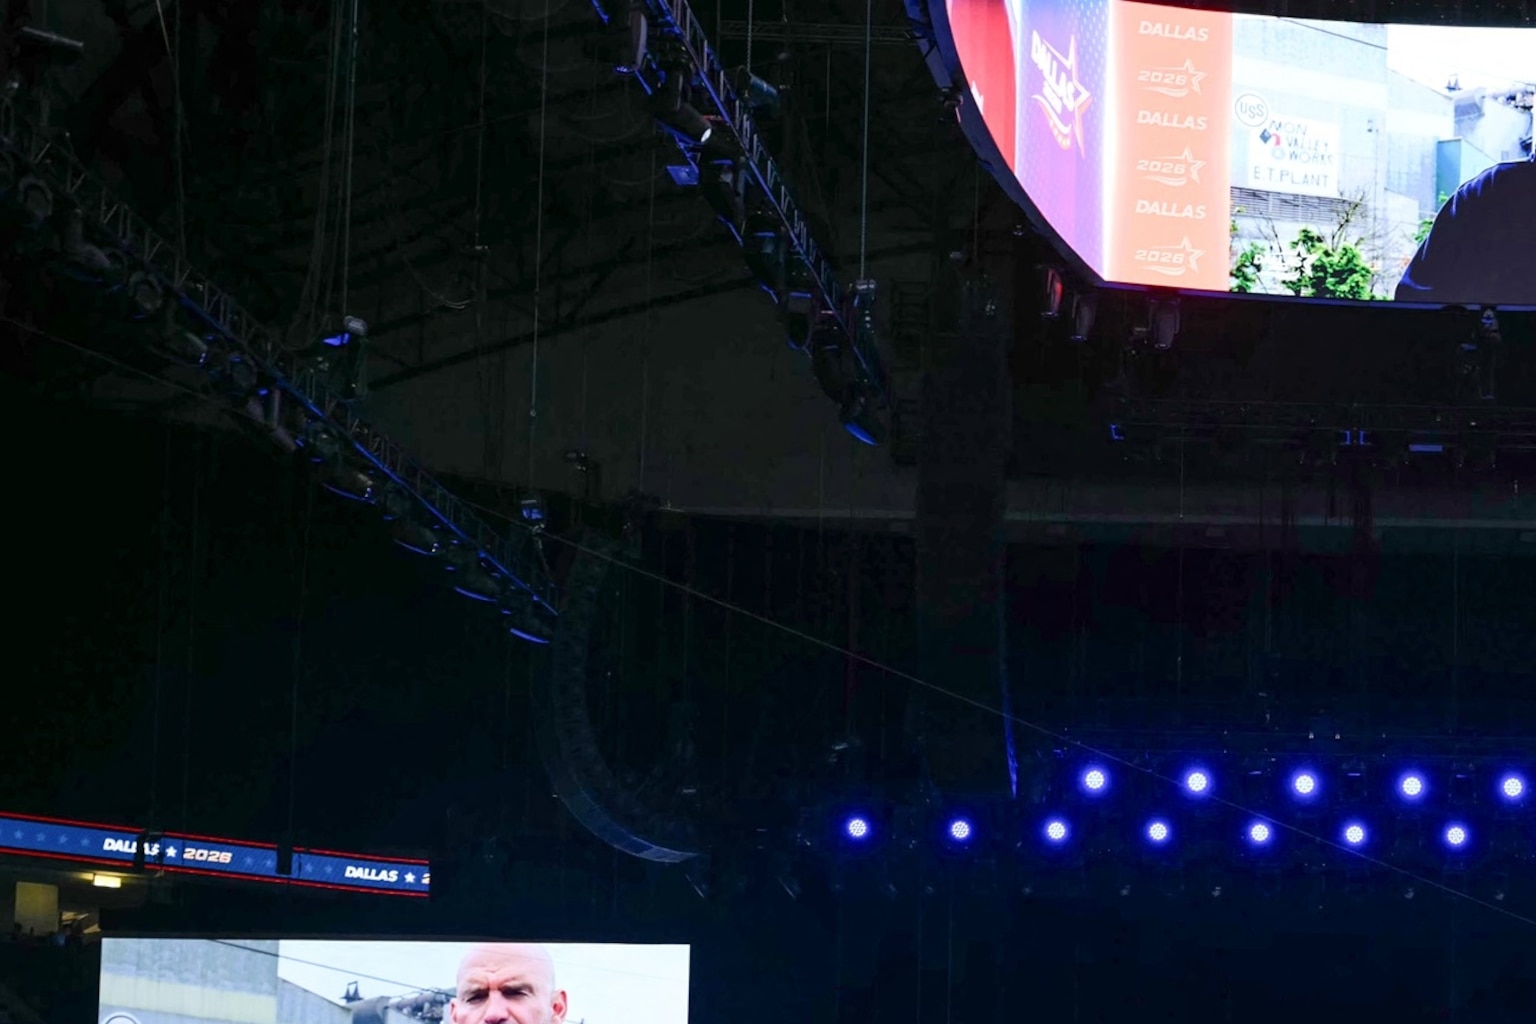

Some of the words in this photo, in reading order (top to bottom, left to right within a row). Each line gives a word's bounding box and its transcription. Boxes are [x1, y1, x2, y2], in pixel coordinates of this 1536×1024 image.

[1138, 21, 1209, 42] DALLAS
[1137, 70, 1188, 86] 2026
[1240, 101, 1264, 119] USS
[1136, 110, 1208, 131] DALLAS
[1136, 159, 1187, 175] 2026
[1135, 199, 1207, 219] DALLAS
[1134, 249, 1185, 265] 2026
[183, 847, 233, 864] 2026
[344, 866, 399, 882] DALLAS
